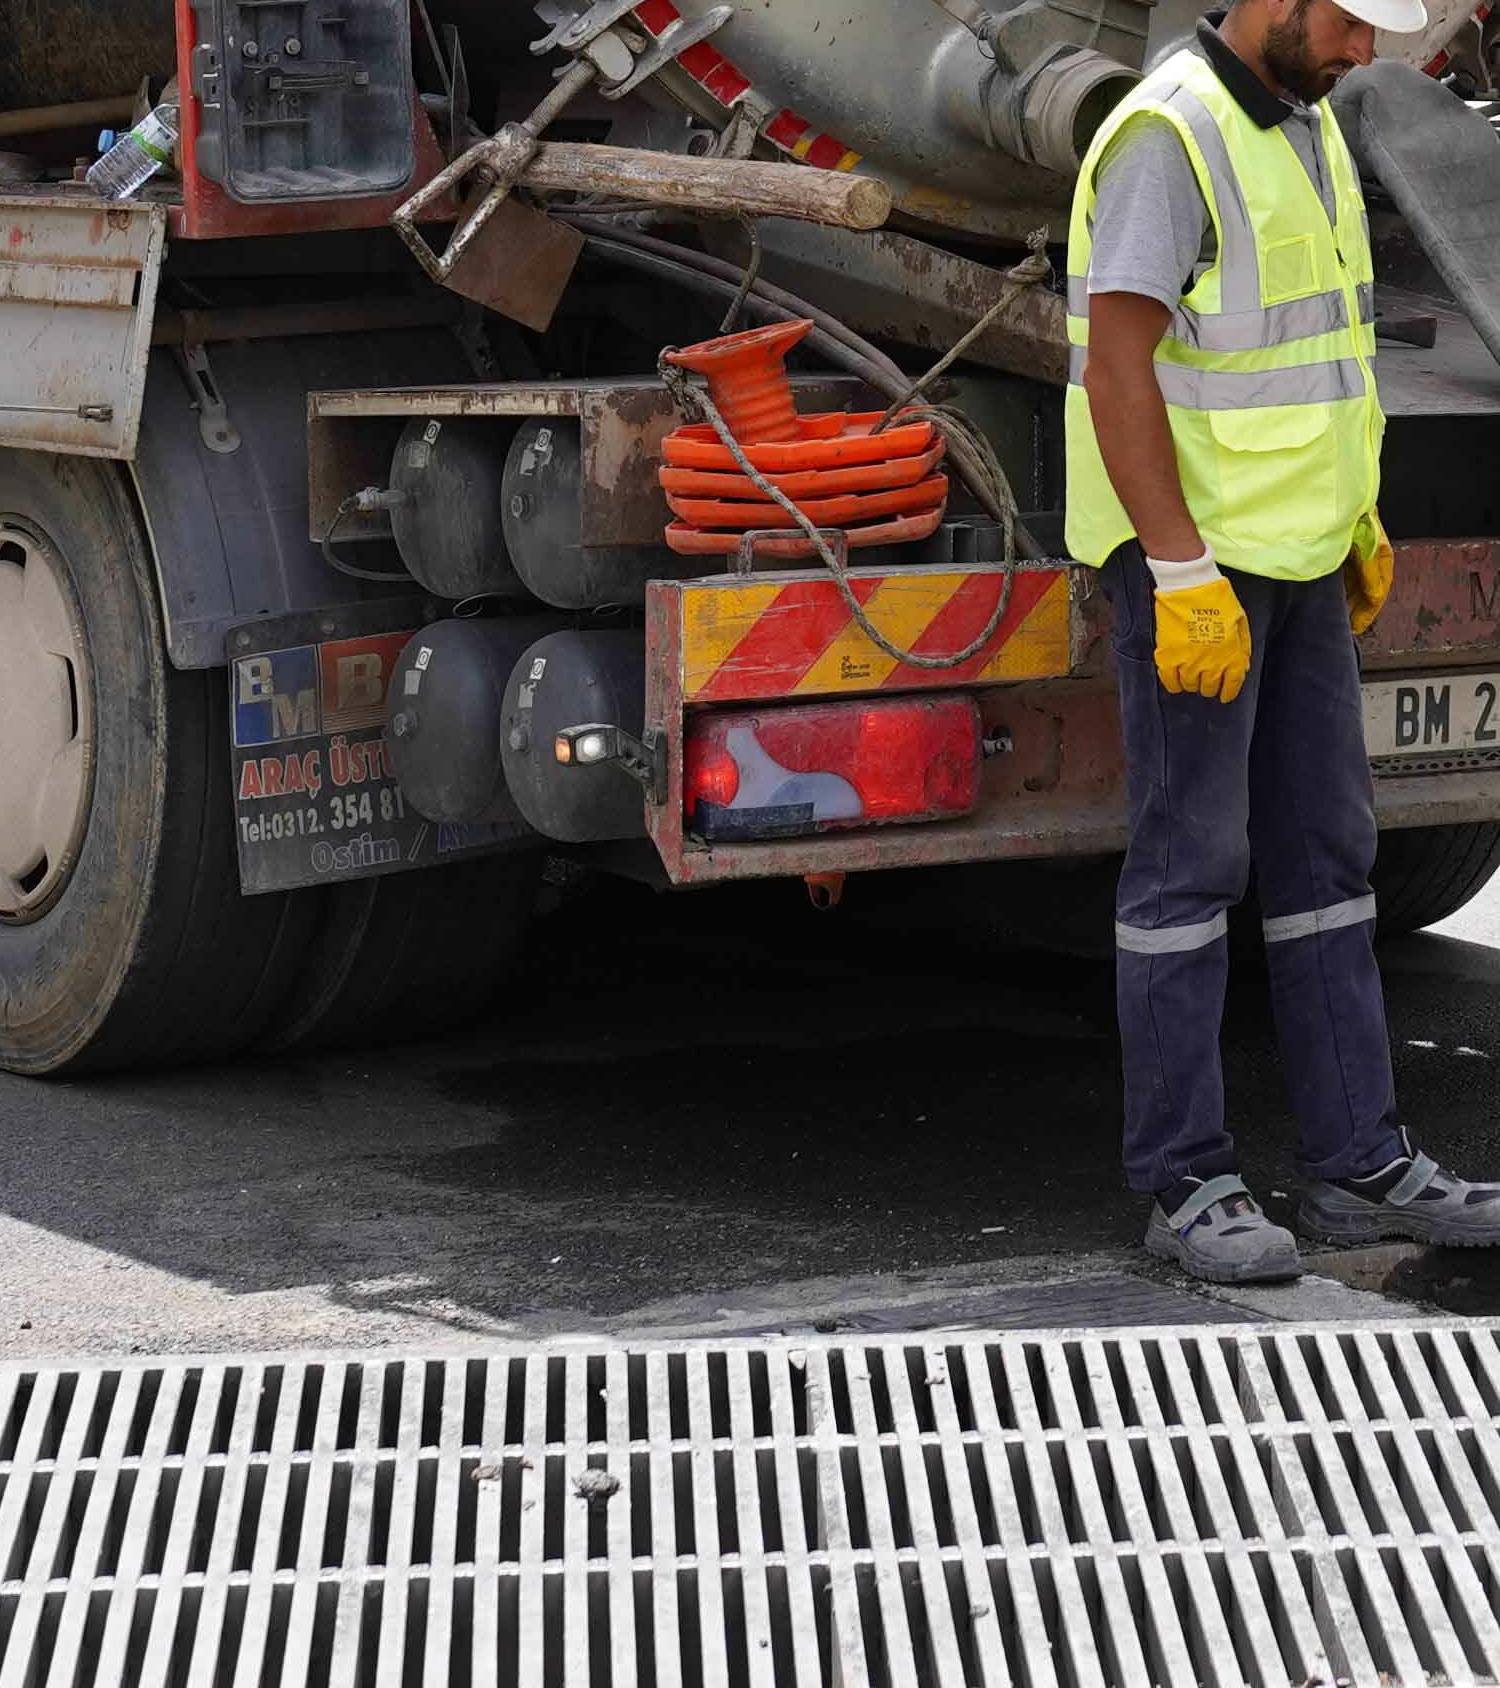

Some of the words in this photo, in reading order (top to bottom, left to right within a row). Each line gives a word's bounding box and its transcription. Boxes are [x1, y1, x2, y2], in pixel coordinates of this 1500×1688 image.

[1394, 684, 1451, 748] BM
[239, 750, 322, 801] ARAÇ
[330, 791, 374, 831] 354
[310, 832, 401, 874] Ostim
